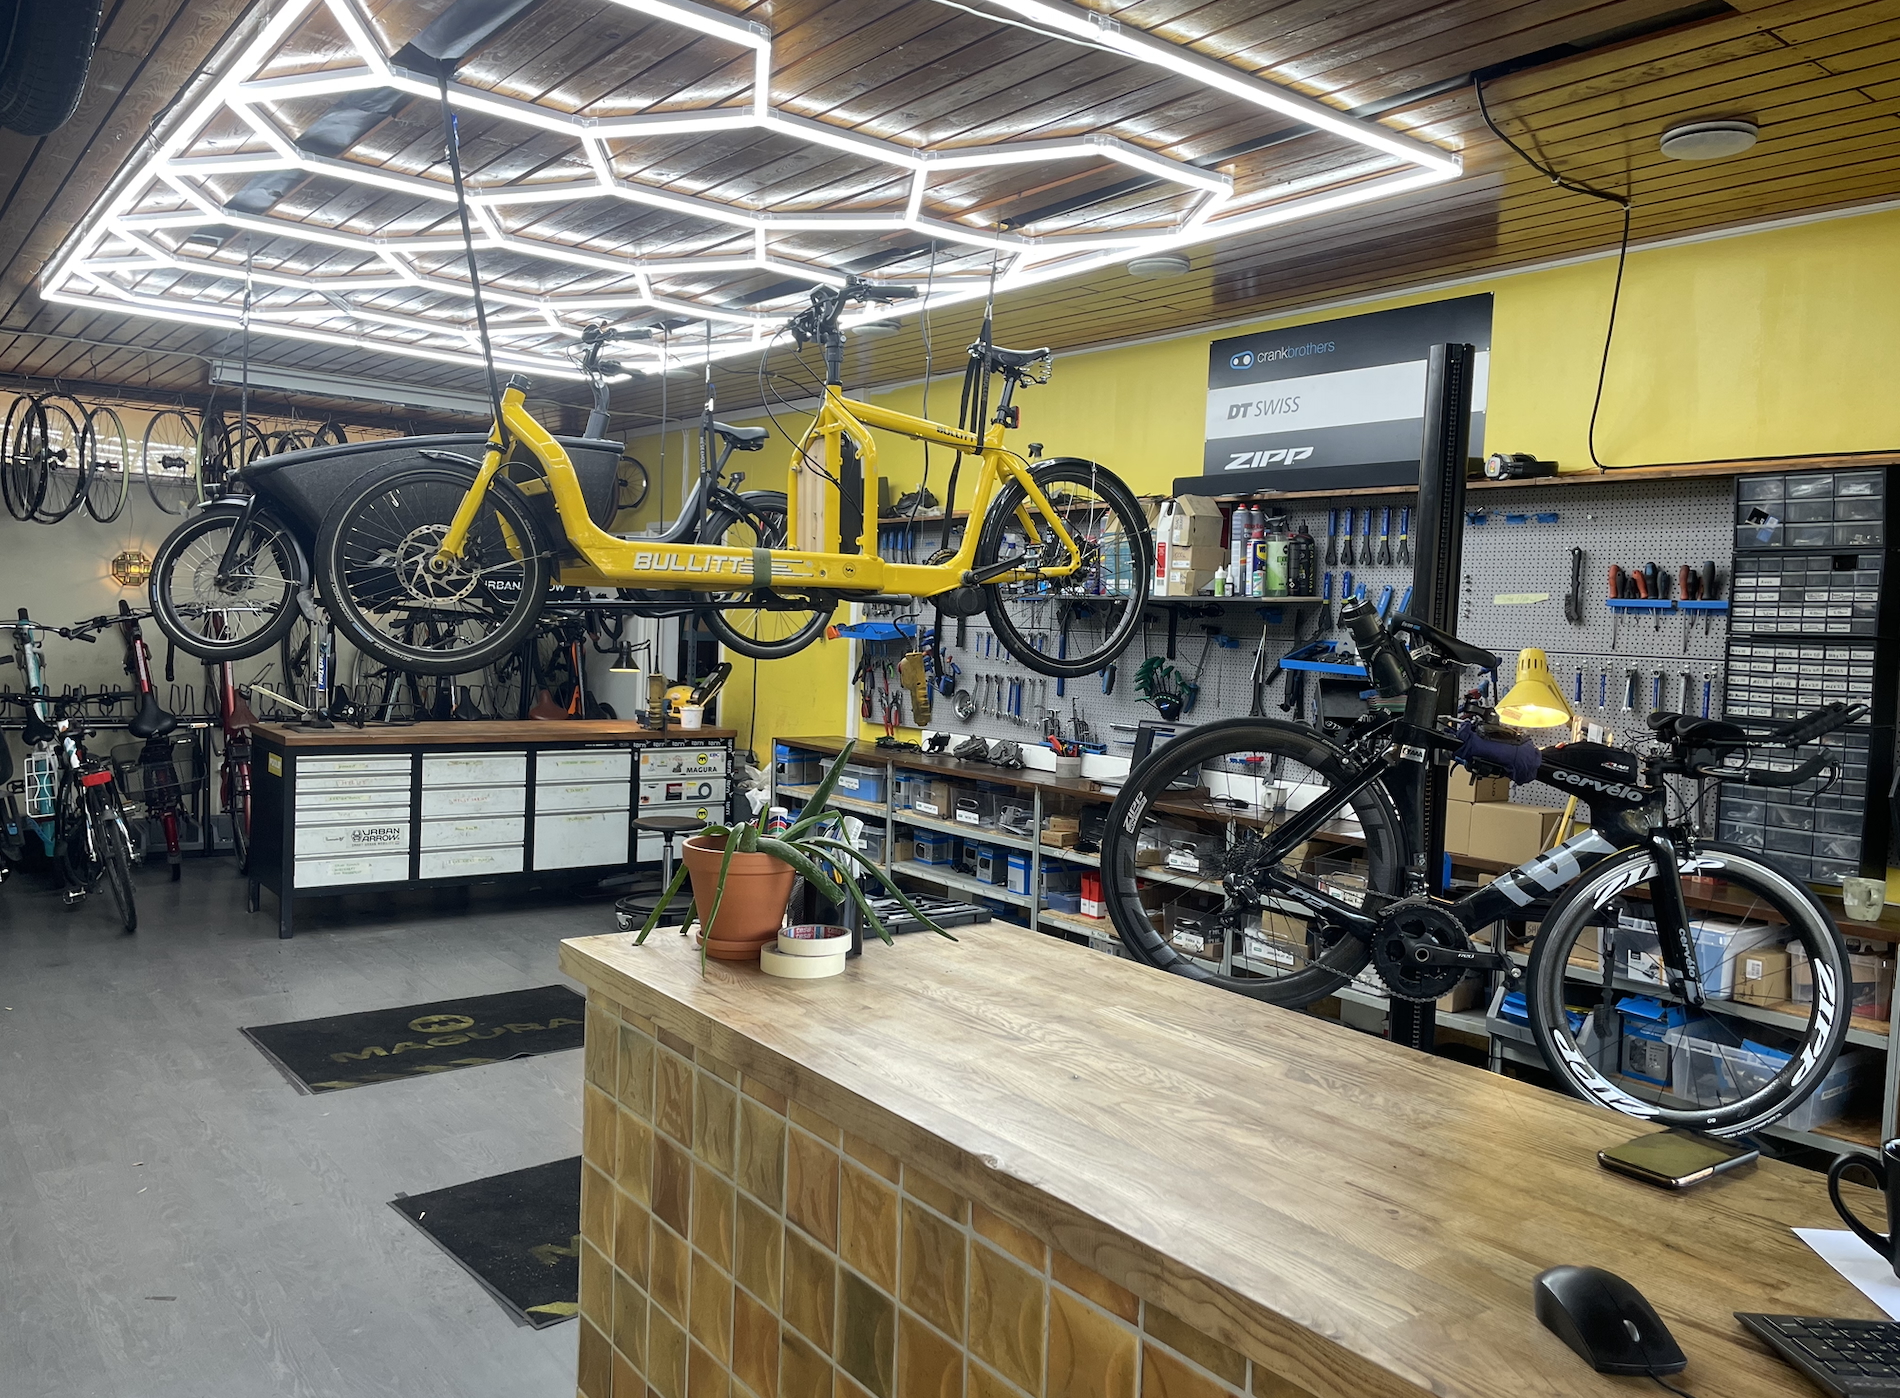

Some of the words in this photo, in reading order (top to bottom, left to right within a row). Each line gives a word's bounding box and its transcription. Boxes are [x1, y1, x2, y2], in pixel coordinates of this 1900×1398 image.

[1257, 340, 1335, 363] crankbrothers
[1226, 402, 1252, 420] DT
[1254, 396, 1301, 417] SWISS
[1224, 446, 1314, 470] ZIPP
[633, 552, 745, 573] BULLITT
[1552, 770, 1644, 802] cervélo
[361, 834, 400, 842] ARROW
[1678, 928, 1696, 978] cervélo
[1790, 957, 1837, 1087] ZIPP
[330, 1017, 584, 1062] MAGURA
[1553, 1029, 1660, 1116] ZIPP
